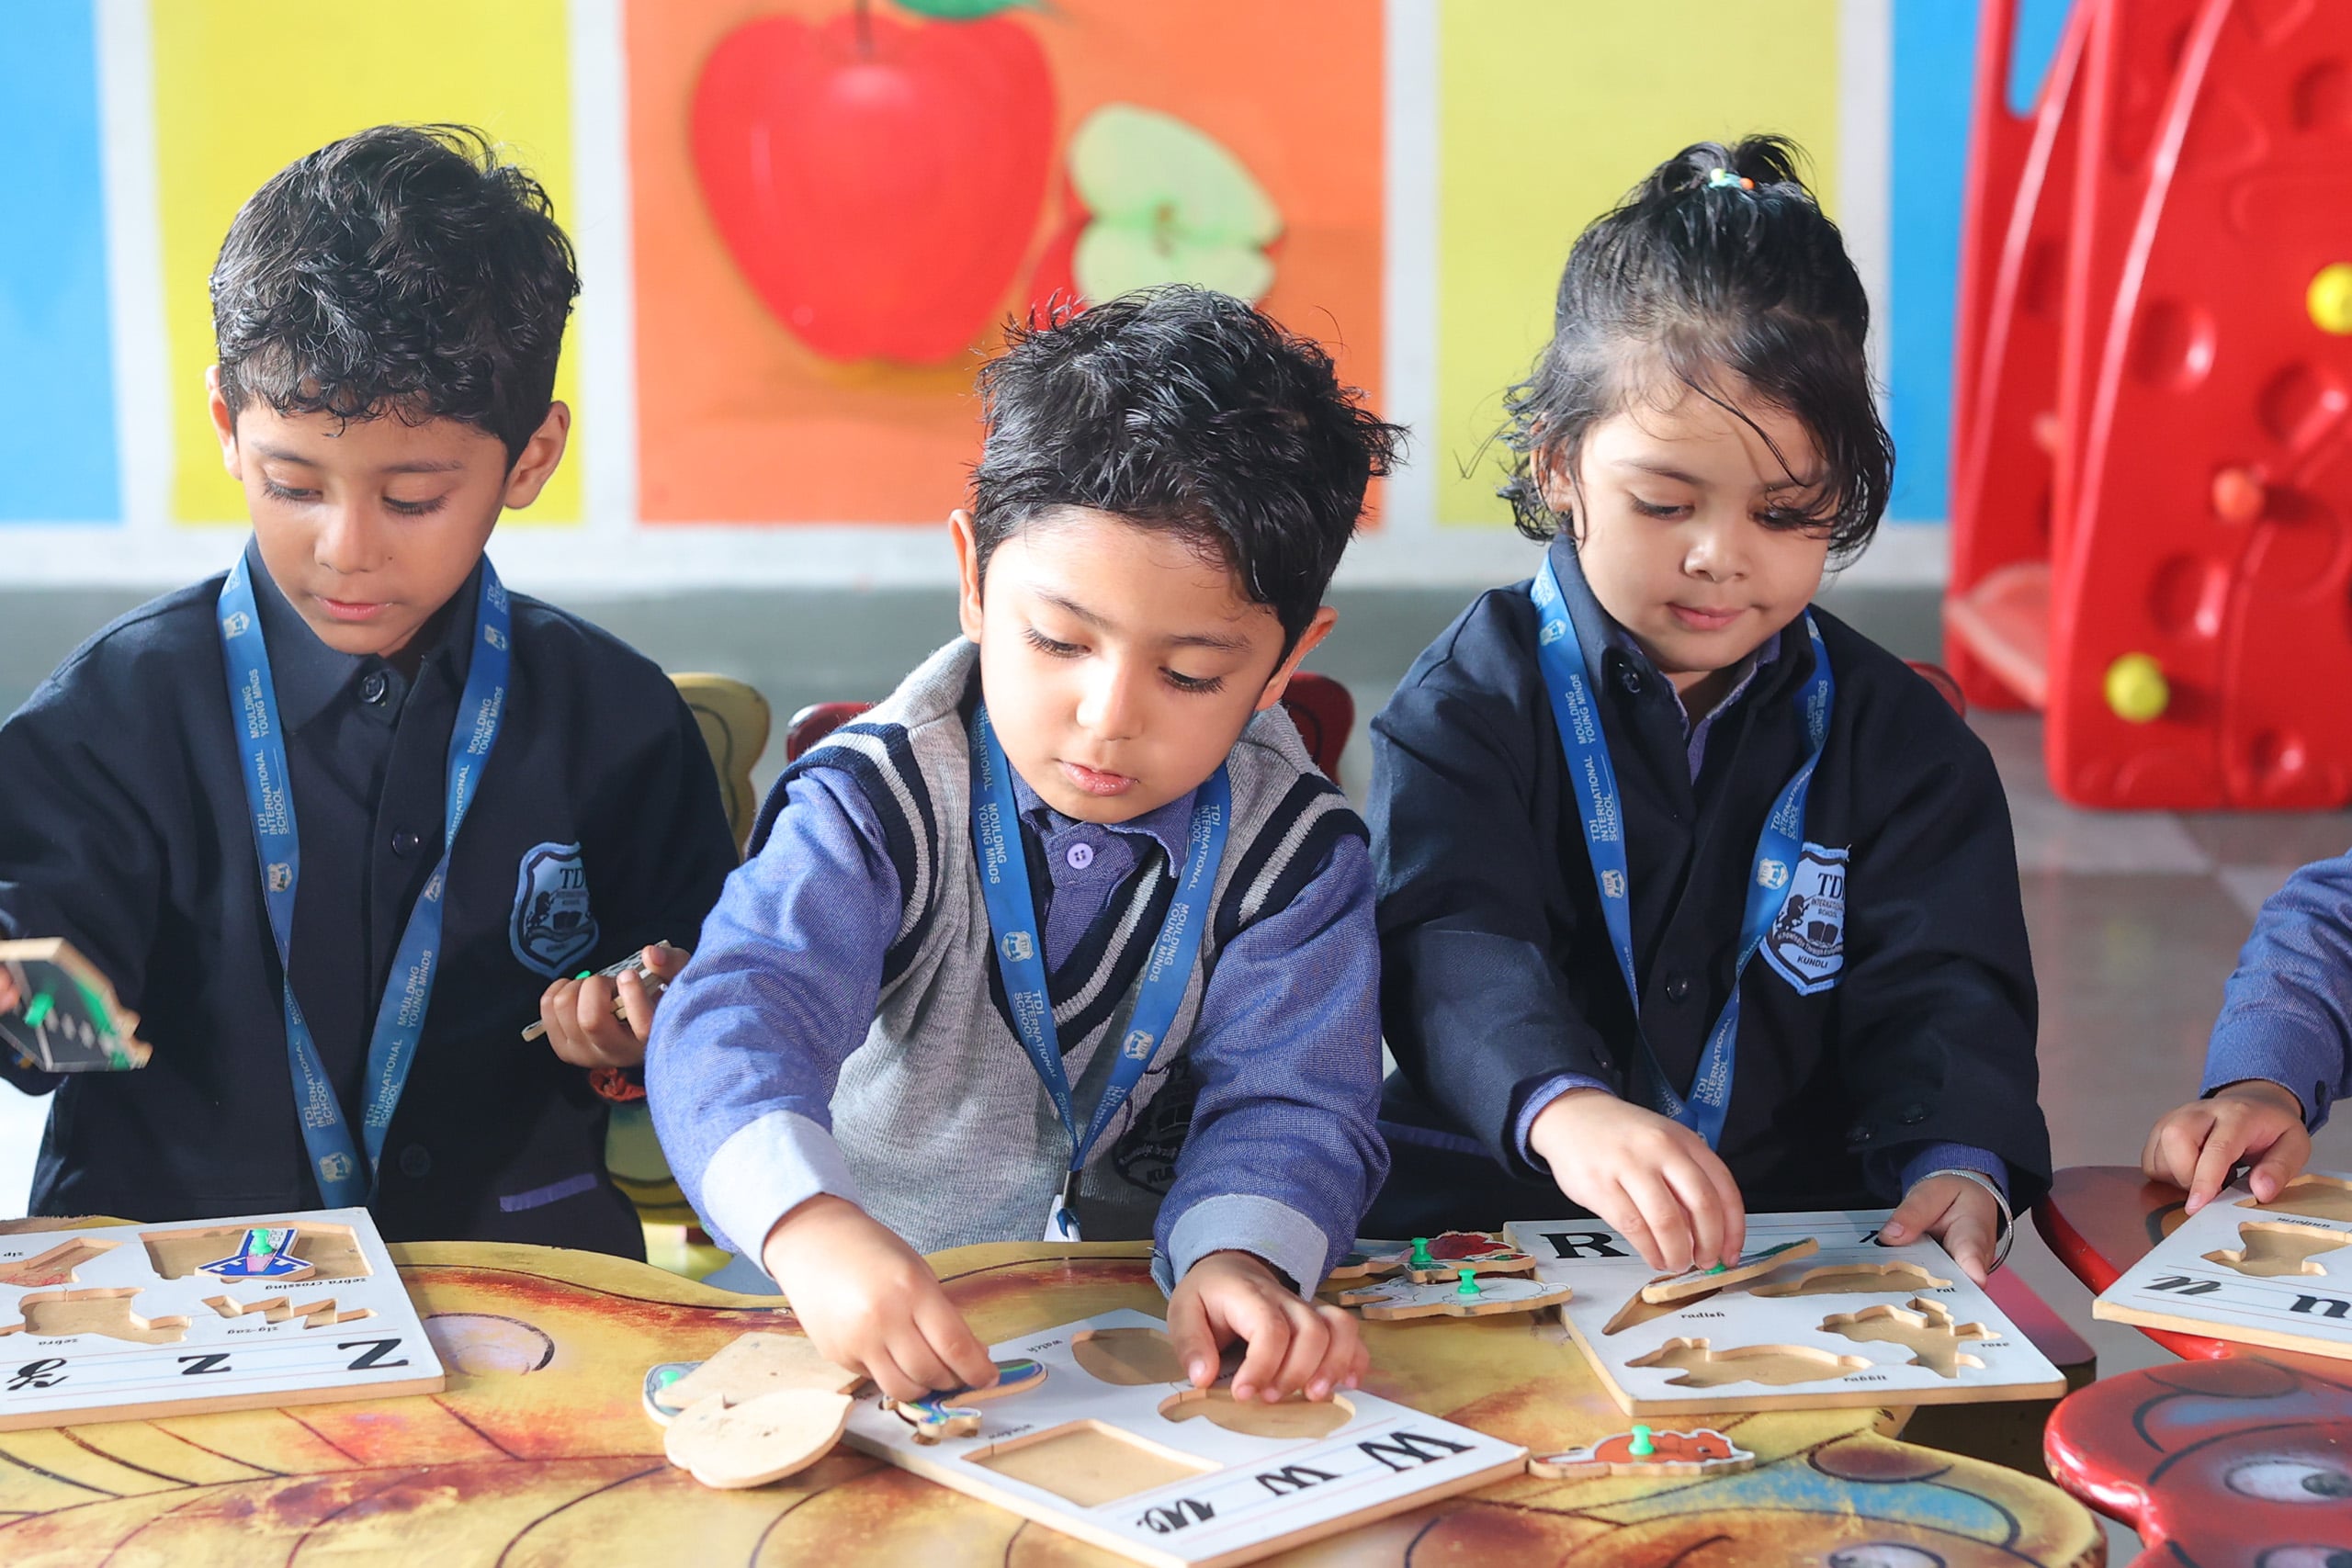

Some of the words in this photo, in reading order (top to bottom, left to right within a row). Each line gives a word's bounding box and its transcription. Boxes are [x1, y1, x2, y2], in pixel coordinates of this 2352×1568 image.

[249, 669, 263, 699] MINDS
[1569, 673, 1587, 705] MINDS
[243, 685, 260, 739] MOULDING
[255, 700, 269, 737] YOUNG
[467, 698, 492, 754] MOULDING
[476, 720, 496, 756] YOUNG
[491, 686, 504, 718] MINDS
[1566, 691, 1587, 744] MOULDING
[1579, 705, 1596, 744] YOUNG
[254, 749, 277, 836] INTERNATIONAL
[273, 787, 288, 835] SCHOOL
[1584, 755, 1609, 842] INTERNATIONAL
[257, 812, 268, 836] TDI
[978, 804, 993, 845] YOUNG
[988, 803, 1007, 864] MOULDING
[1211, 804, 1221, 826] TDI
[1589, 819, 1600, 842] TDI
[1604, 793, 1618, 841] SCHOOL
[1770, 811, 1781, 831] TDI
[985, 847, 1001, 885] MINDS
[1187, 805, 1212, 891] INTERNATIONAL
[560, 868, 585, 889] TD
[1162, 902, 1182, 943] YOUNG
[1164, 902, 1190, 966] MOULDING
[1148, 944, 1168, 983] MINDS
[1797, 955, 1829, 968] KUNDLI
[397, 965, 420, 1026] MOULDING
[408, 987, 425, 1028] YOUNG
[418, 950, 433, 987] MINDS
[1033, 989, 1046, 1015] TDI
[1023, 991, 1057, 1079] INTERNATIONAL
[1702, 1016, 1734, 1105] INTERNATIONAL
[294, 1036, 326, 1128] INTERNATIONAL
[370, 1039, 402, 1127] INTERNATIONAL
[1692, 1077, 1709, 1100] TDI
[1711, 1057, 1728, 1108] SCHOOL
[303, 1107, 316, 1129] TDI
[378, 1082, 400, 1128] SCHOOL
[2278, 1217, 2331, 1228] uniform
[1538, 1232, 1631, 1258] R
[265, 1280, 322, 1291] crossing
[227, 1325, 279, 1335] zig-zag
[1680, 1311, 1725, 1319] radish
[38, 1337, 79, 1346] zebra
[1026, 1339, 1063, 1353] watch
[1843, 1374, 1889, 1382] rabbit
